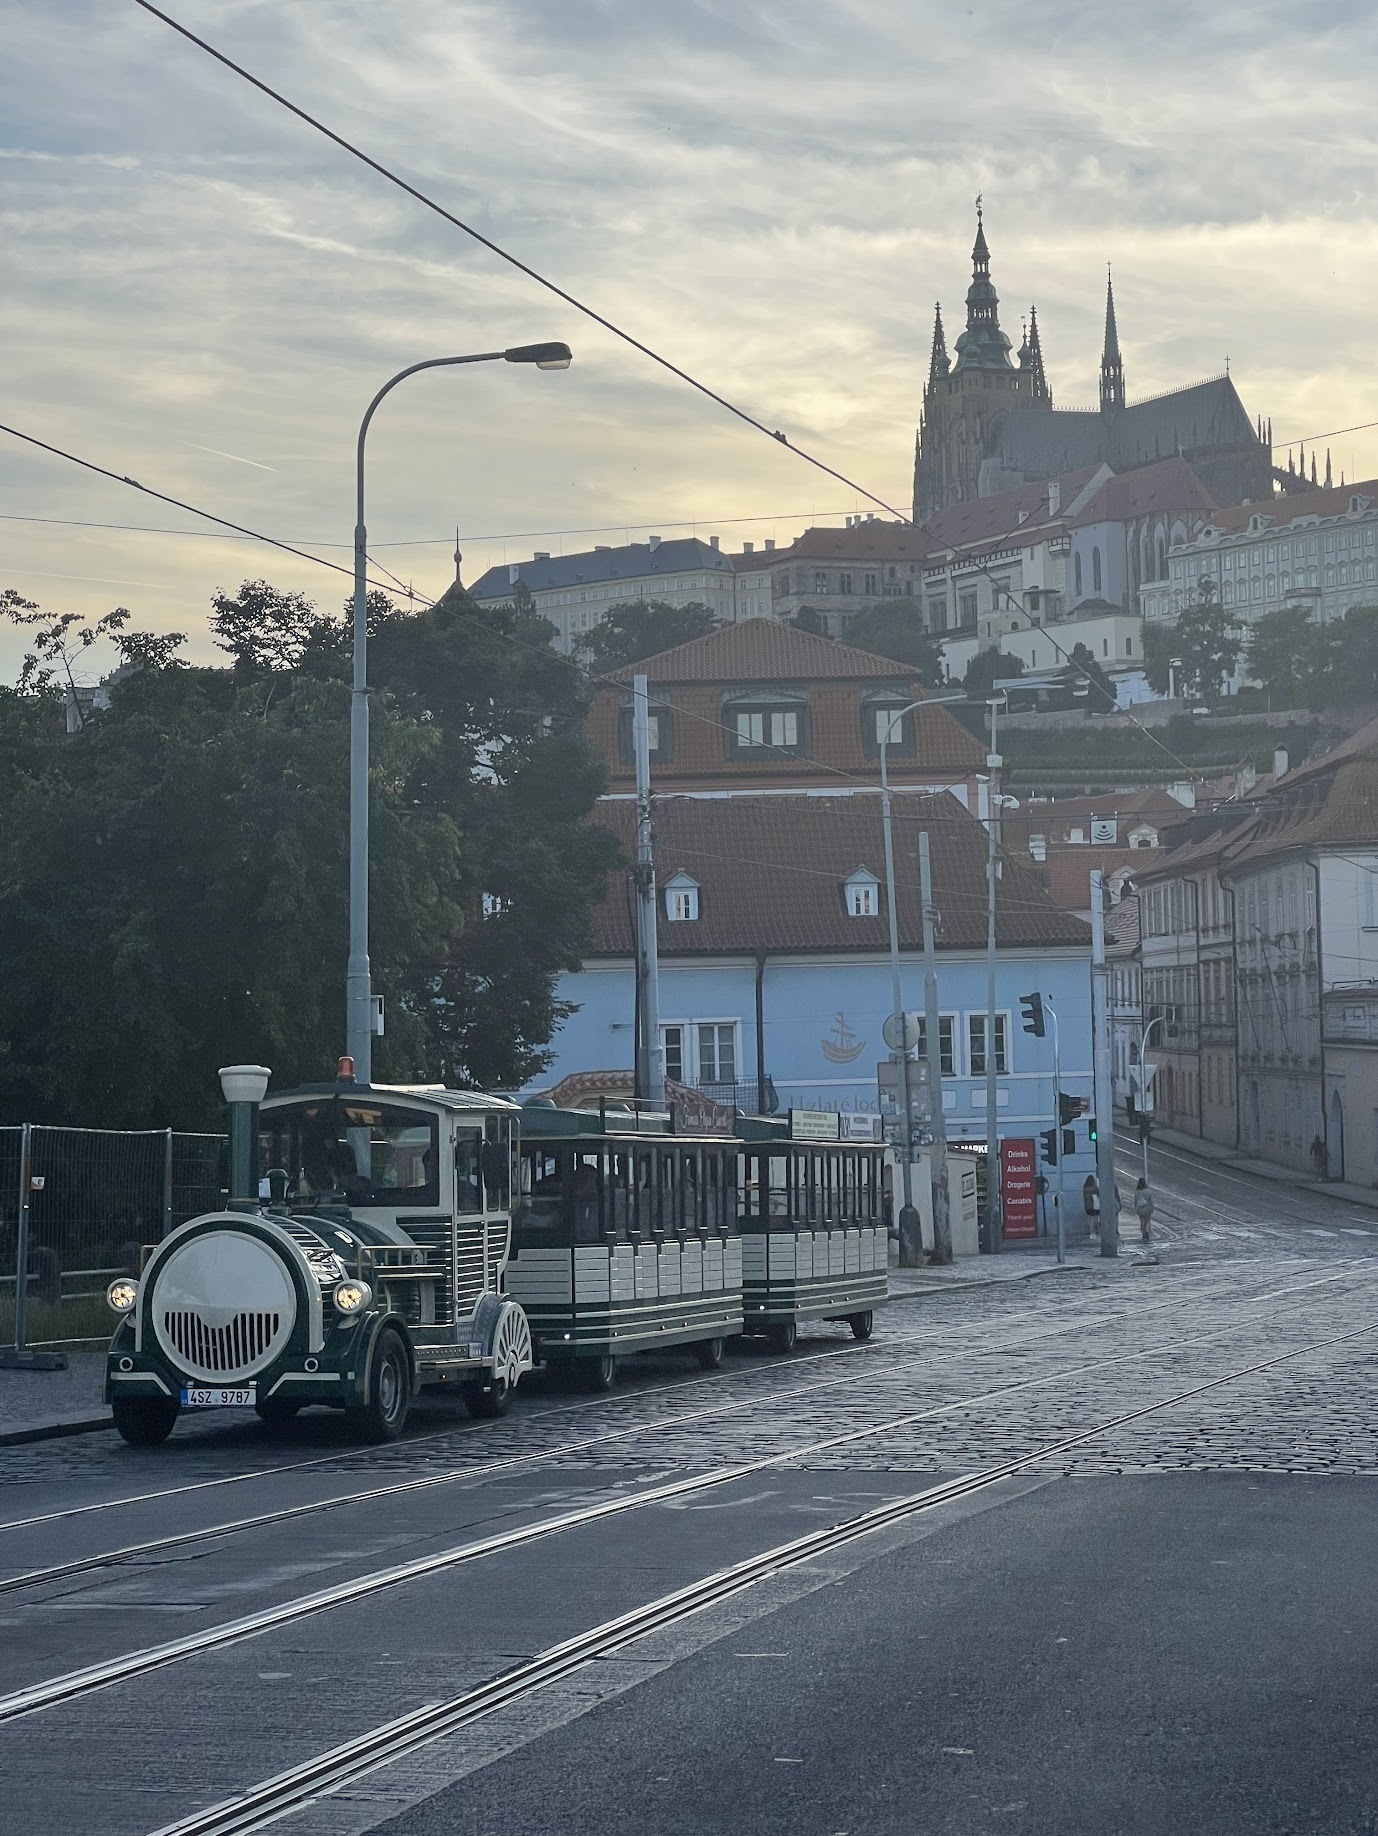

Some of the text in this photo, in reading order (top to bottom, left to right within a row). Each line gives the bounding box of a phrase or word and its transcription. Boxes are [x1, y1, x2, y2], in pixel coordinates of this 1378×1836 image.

[1008, 1150, 1029, 1158] Drinks
[1007, 1164, 1031, 1173] Alkohol
[1006, 1197, 1032, 1205] Canabis
[190, 1391, 212, 1404] 4SZ
[221, 1391, 250, 1404] 9787
